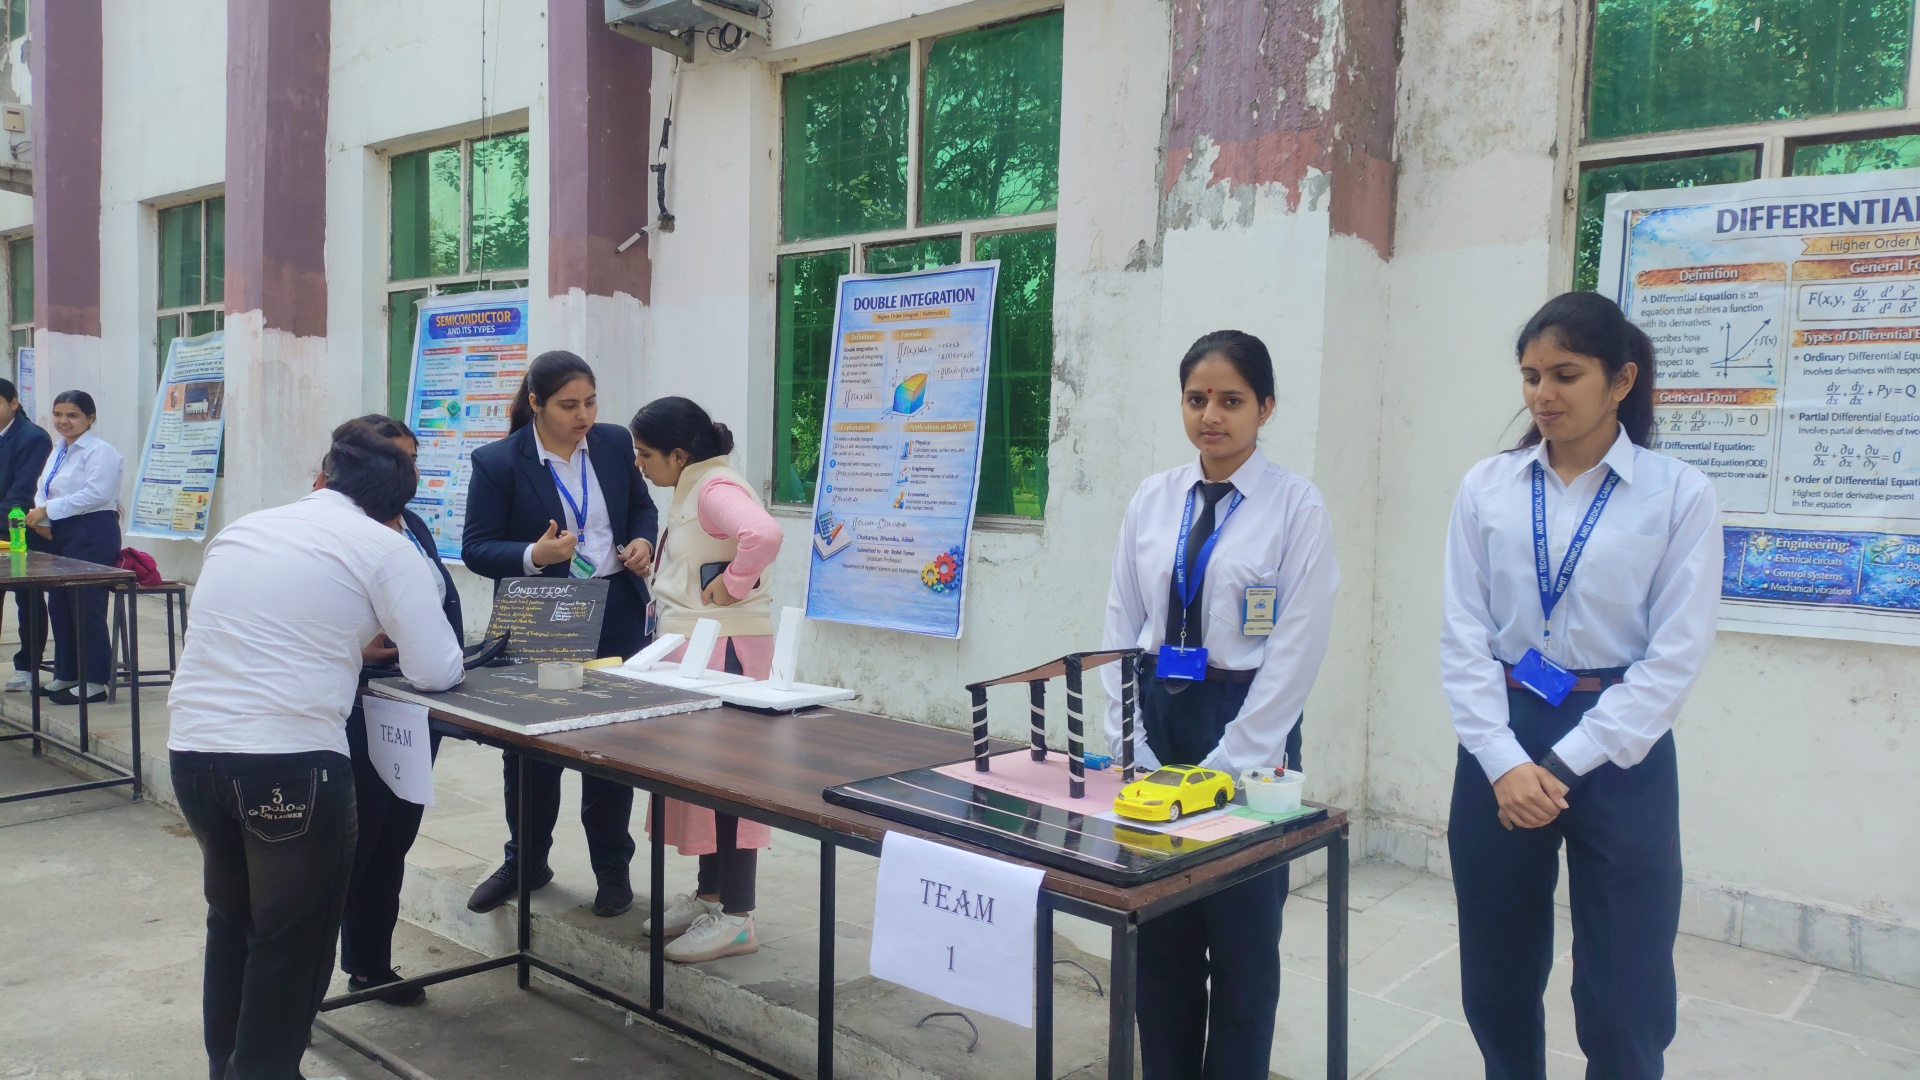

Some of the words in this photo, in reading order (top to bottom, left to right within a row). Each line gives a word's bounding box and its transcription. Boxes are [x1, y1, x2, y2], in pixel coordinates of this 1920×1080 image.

[1830, 239, 1871, 253] Higher
[1874, 236, 1910, 249] Order
[1850, 259, 1903, 274] General
[1679, 268, 1739, 282] Definition
[853, 295, 897, 311] DOUBLE
[900, 287, 975, 308] INTEGRATION
[1642, 295, 1648, 303] A
[1650, 292, 1697, 304] Differential
[1699, 291, 1738, 303] Equation
[1740, 291, 1746, 299] is
[1748, 291, 1758, 299] an
[1641, 307, 1675, 317] equation
[1677, 307, 1692, 315] that
[1694, 305, 1721, 314] relates
[1730, 303, 1764, 313] function
[435, 310, 512, 327] SEMICONDUCTOR
[1640, 320, 1656, 328] with
[1658, 319, 1668, 328] its
[1669, 318, 1712, 328] derivatives.
[447, 327, 461, 336] AND
[462, 326, 472, 334] ITS
[473, 325, 496, 334] TYPES
[851, 333, 875, 341] Definition
[901, 330, 922, 338] Formula
[1683, 333, 1701, 342] how
[1802, 331, 1832, 345] Types
[1835, 331, 1847, 341] of
[1849, 329, 1912, 341] Differential
[1652, 345, 1676, 357] antity
[1677, 345, 1709, 356] changes
[1803, 353, 1846, 363] Ordinary
[1848, 351, 1902, 361] Differential
[1668, 369, 1700, 378] variable.
[1803, 367, 1833, 375] Involves
[1834, 366, 1875, 375] derivatives
[1877, 366, 1895, 375] with
[1897, 367, 1920, 377] respec
[1659, 392, 1704, 403] General
[1706, 392, 1737, 403] Form
[1799, 412, 1829, 421] Partial
[1831, 412, 1882, 422] Differential
[1884, 413, 1920, 423] Equatio
[1798, 426, 1829, 435] Involves
[1830, 427, 1854, 436] partial
[1855, 426, 1895, 435] derivatives
[1896, 427, 1905, 435] of
[1665, 442, 1711, 450] Differential
[1714, 442, 1755, 453] Equation:
[1711, 458, 1745, 468] Equation
[1746, 459, 1768, 468] (ODE)
[1706, 471, 1728, 479] respect
[1793, 475, 1821, 484] Order
[1823, 475, 1833, 484] of
[1834, 476, 1888, 486] Differential
[1534, 472, 1543, 495] CAMPUS
[1792, 489, 1822, 499] Highest
[1823, 490, 1844, 498] order
[1846, 490, 1884, 499] derivative
[1885, 492, 1915, 502] present
[1535, 496, 1543, 521] MEDICAL
[1801, 500, 1814, 508] the
[1816, 501, 1851, 510] equation
[1182, 504, 1192, 526] MEDICAL
[1180, 526, 1188, 536] AND
[1536, 521, 1545, 535] AND
[1556, 576, 1568, 593] RPIIT
[1562, 540, 1584, 575] TECHNICAL
[1579, 524, 1592, 539] AND
[1586, 500, 1605, 526] MEDICAL
[1599, 475, 1617, 499] CAMPUS
[1776, 536, 1850, 552] Engineering:
[1177, 537, 1186, 567] TECHNICAL
[1536, 537, 1547, 574] TECHNICAL
[1774, 554, 1812, 565] Electrical
[1813, 557, 1843, 566] circuits
[1773, 568, 1806, 579] Control
[1806, 571, 1843, 582] systems
[508, 581, 571, 595] CONDITION
[1770, 582, 1814, 593] Mechanical
[1814, 585, 1852, 596] vibrations
[379, 723, 412, 747] TEAM
[393, 762, 401, 780] 2
[271, 787, 283, 804] 3
[919, 877, 995, 926] TEAM
[946, 945, 956, 973] 1
